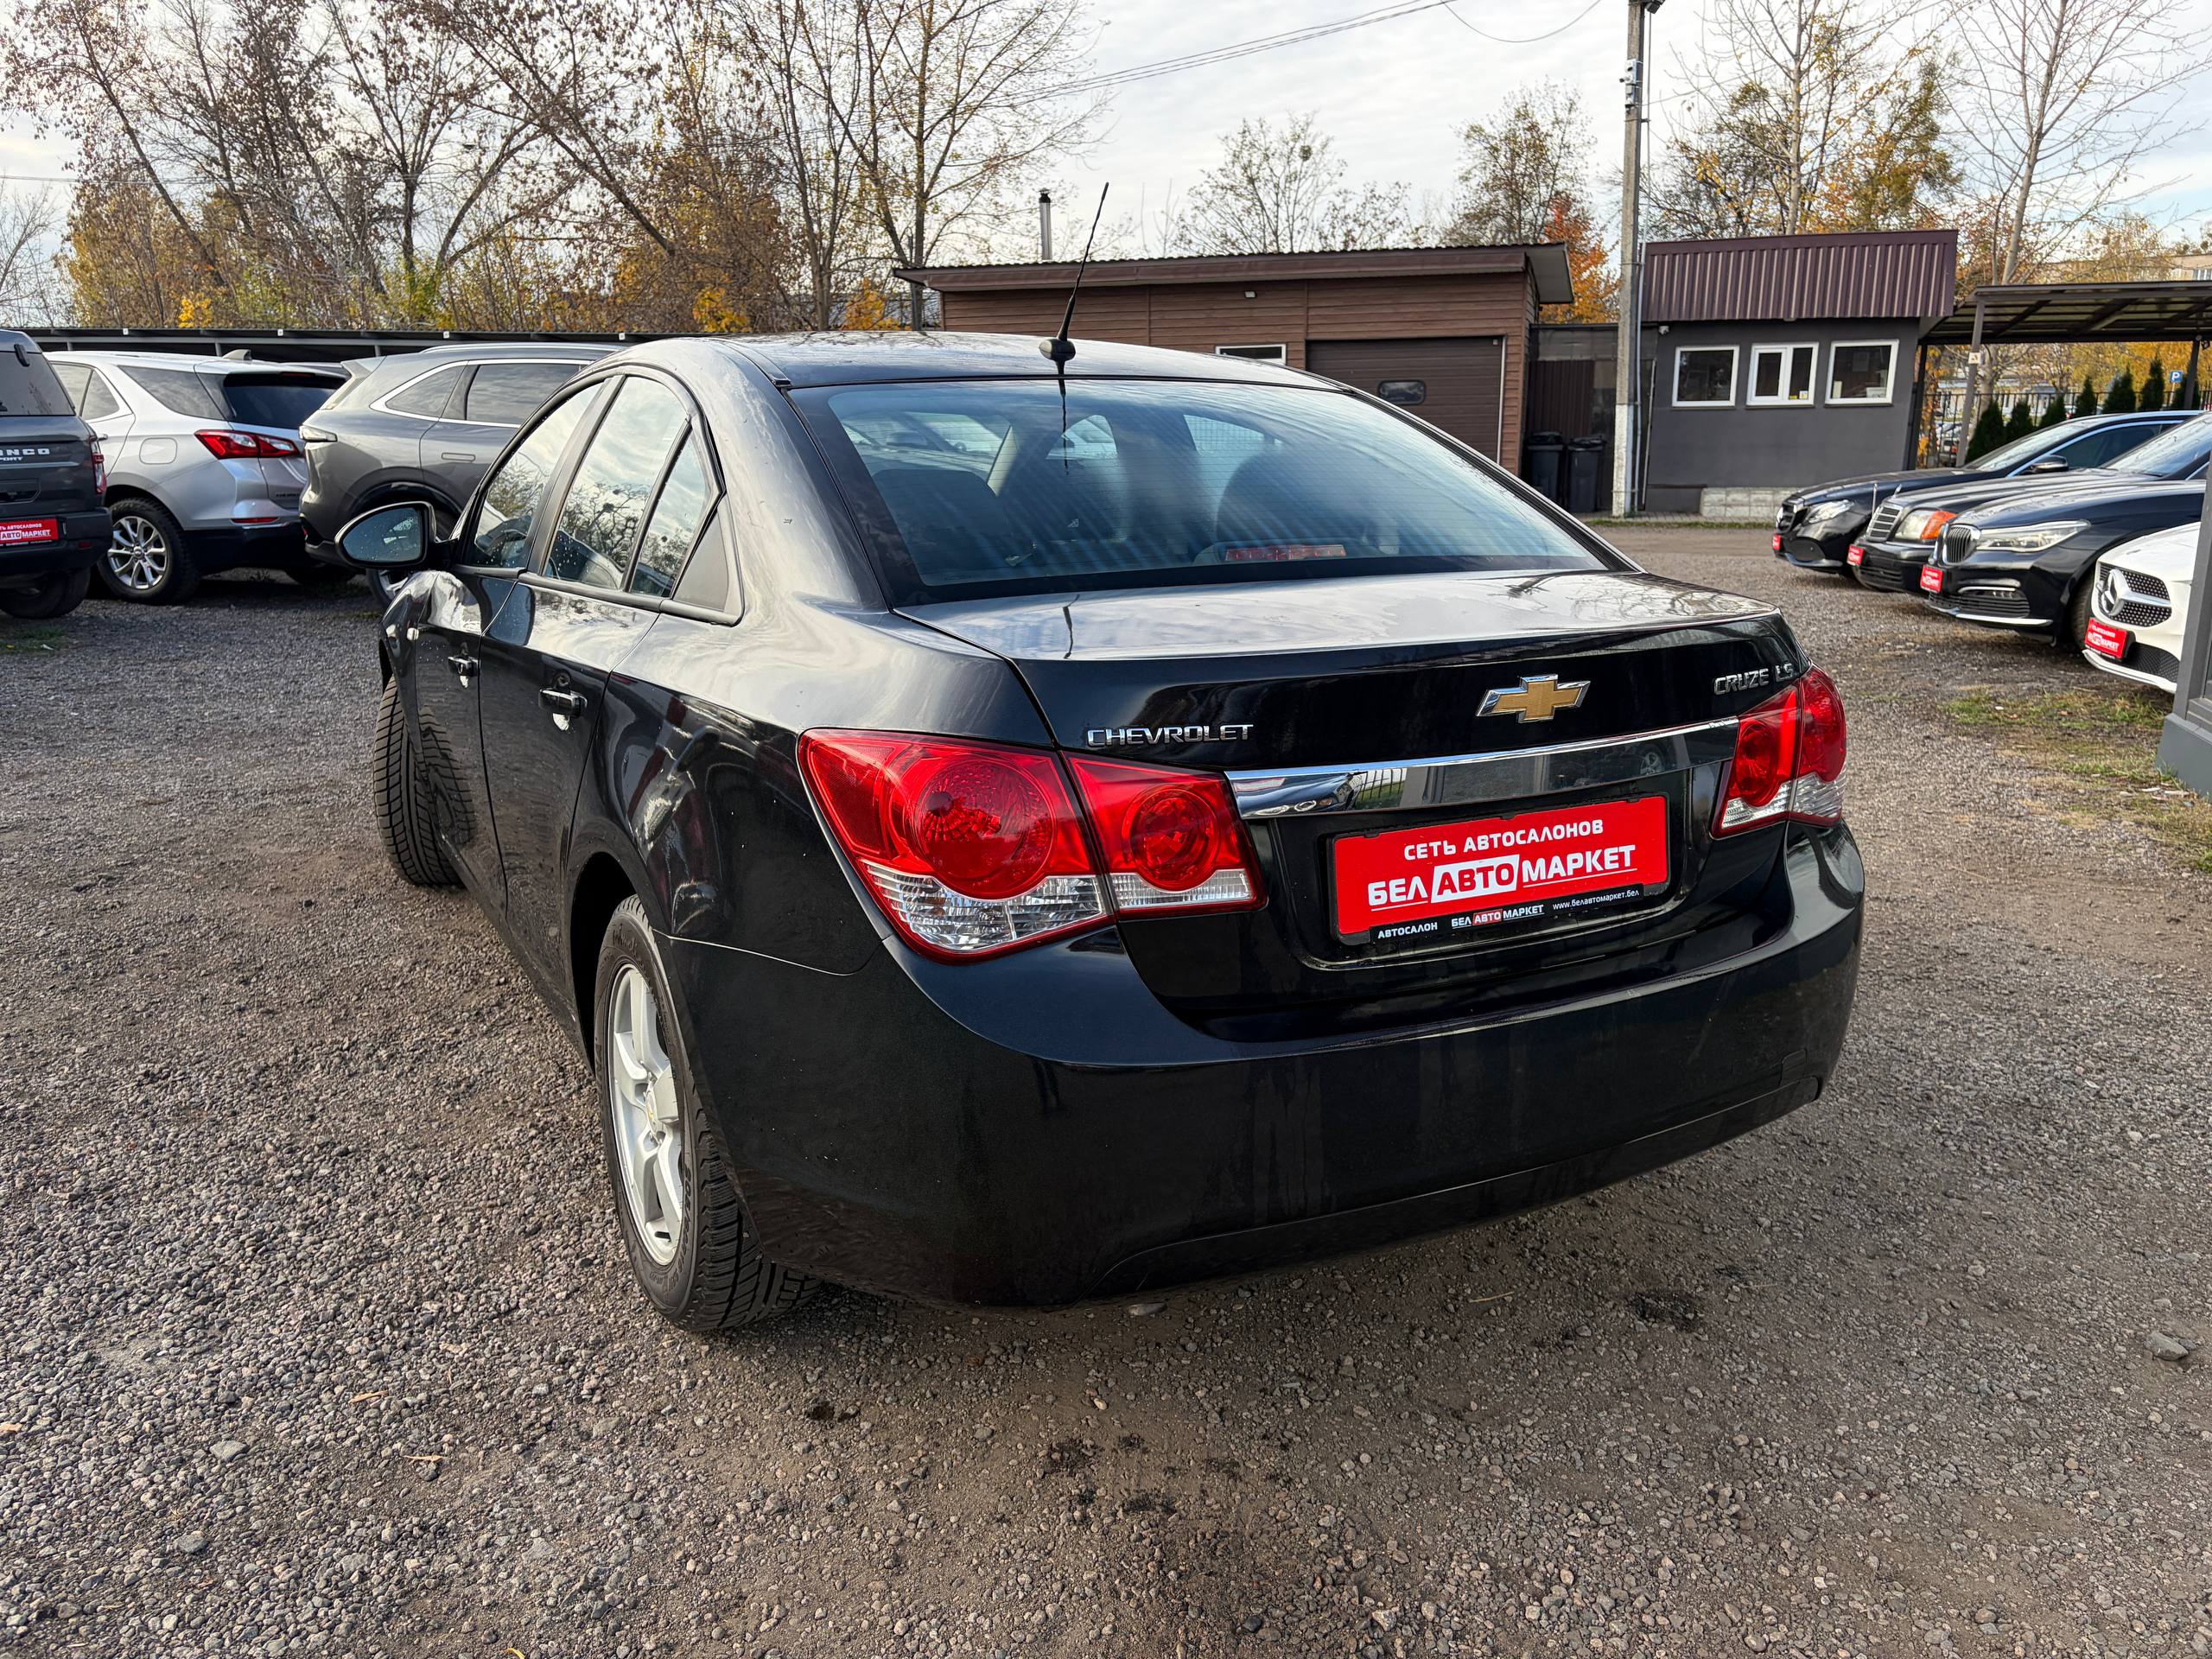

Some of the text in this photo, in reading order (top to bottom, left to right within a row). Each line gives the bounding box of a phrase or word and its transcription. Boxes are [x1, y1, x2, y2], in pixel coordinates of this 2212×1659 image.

[2172, 372, 2181, 381] P
[1714, 663, 1794, 695] CRUZE LS
[1087, 724, 1254, 747] CHEVROLET
[1404, 818, 1604, 861] СЕТЬ АВТОСАЛОНОВ
[1377, 921, 1438, 939] АВТОСАЛОН
[1553, 889, 1640, 911] www.белавтомаркет.бел
